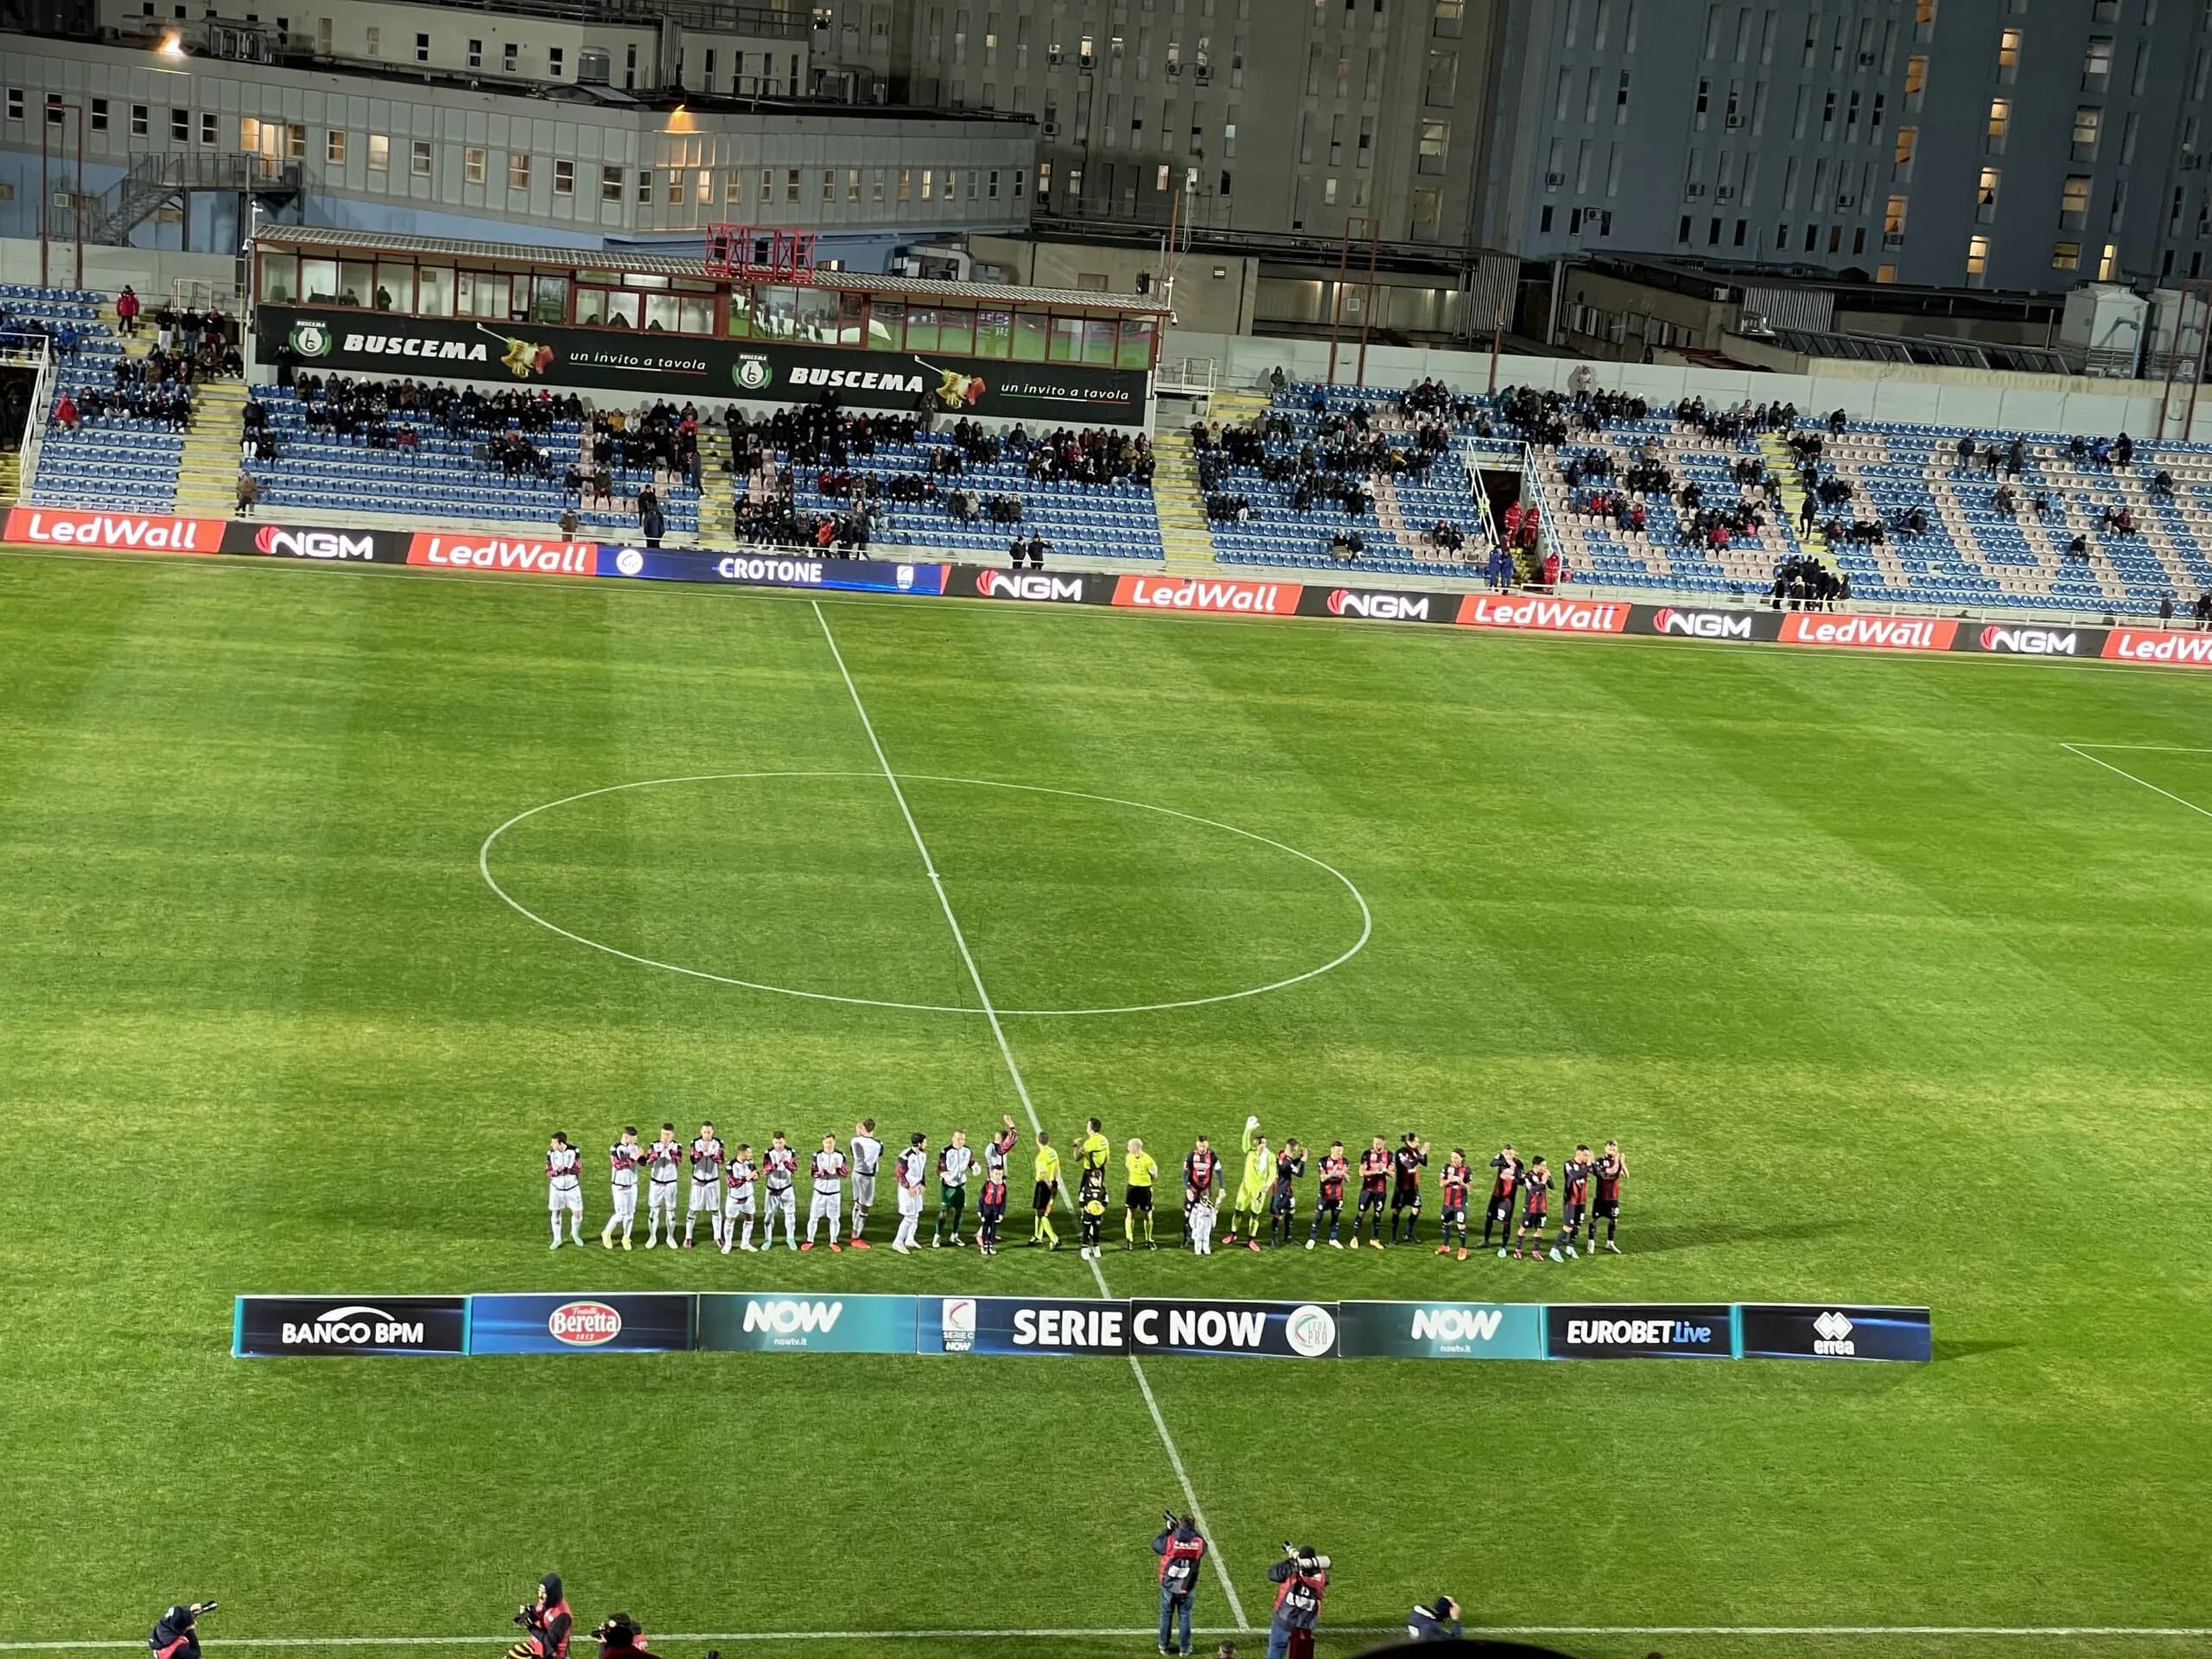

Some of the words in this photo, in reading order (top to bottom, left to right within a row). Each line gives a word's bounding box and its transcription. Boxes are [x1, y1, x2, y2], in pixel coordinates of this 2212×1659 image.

[343, 334, 487, 361] BUSCEMA
[570, 352, 588, 361] un
[594, 352, 639, 366] invito
[644, 357, 652, 366] a
[658, 357, 706, 371] tavola
[788, 367, 924, 393] BUSCEMA
[1001, 383, 1019, 393] un
[1023, 383, 1065, 397] invito
[1071, 388, 1079, 397] a
[1084, 389, 1129, 401] tavola
[29, 514, 197, 549] LedWall
[270, 531, 373, 560] NGM
[428, 537, 588, 572] LedWall
[717, 558, 823, 583] CROTONE
[989, 576, 1083, 601] NGM
[1132, 580, 1277, 611] LedWall
[1338, 594, 1430, 620] NGM
[1474, 599, 1615, 630] LedWall
[1664, 613, 1752, 639] NGM
[1797, 616, 1935, 647] LedWall
[1990, 630, 2077, 655] NGM
[554, 1312, 617, 1334] Beretta
[742, 1300, 843, 1334] NOW
[1013, 1308, 1123, 1347] SERIE
[1133, 1309, 1160, 1344] C
[1168, 1310, 1267, 1347] NOW
[1410, 1309, 1503, 1341] NOW
[282, 1322, 371, 1344] BANCO
[375, 1322, 424, 1344] BPM
[945, 1341, 971, 1351] NOW
[1307, 1331, 1327, 1345] PRO
